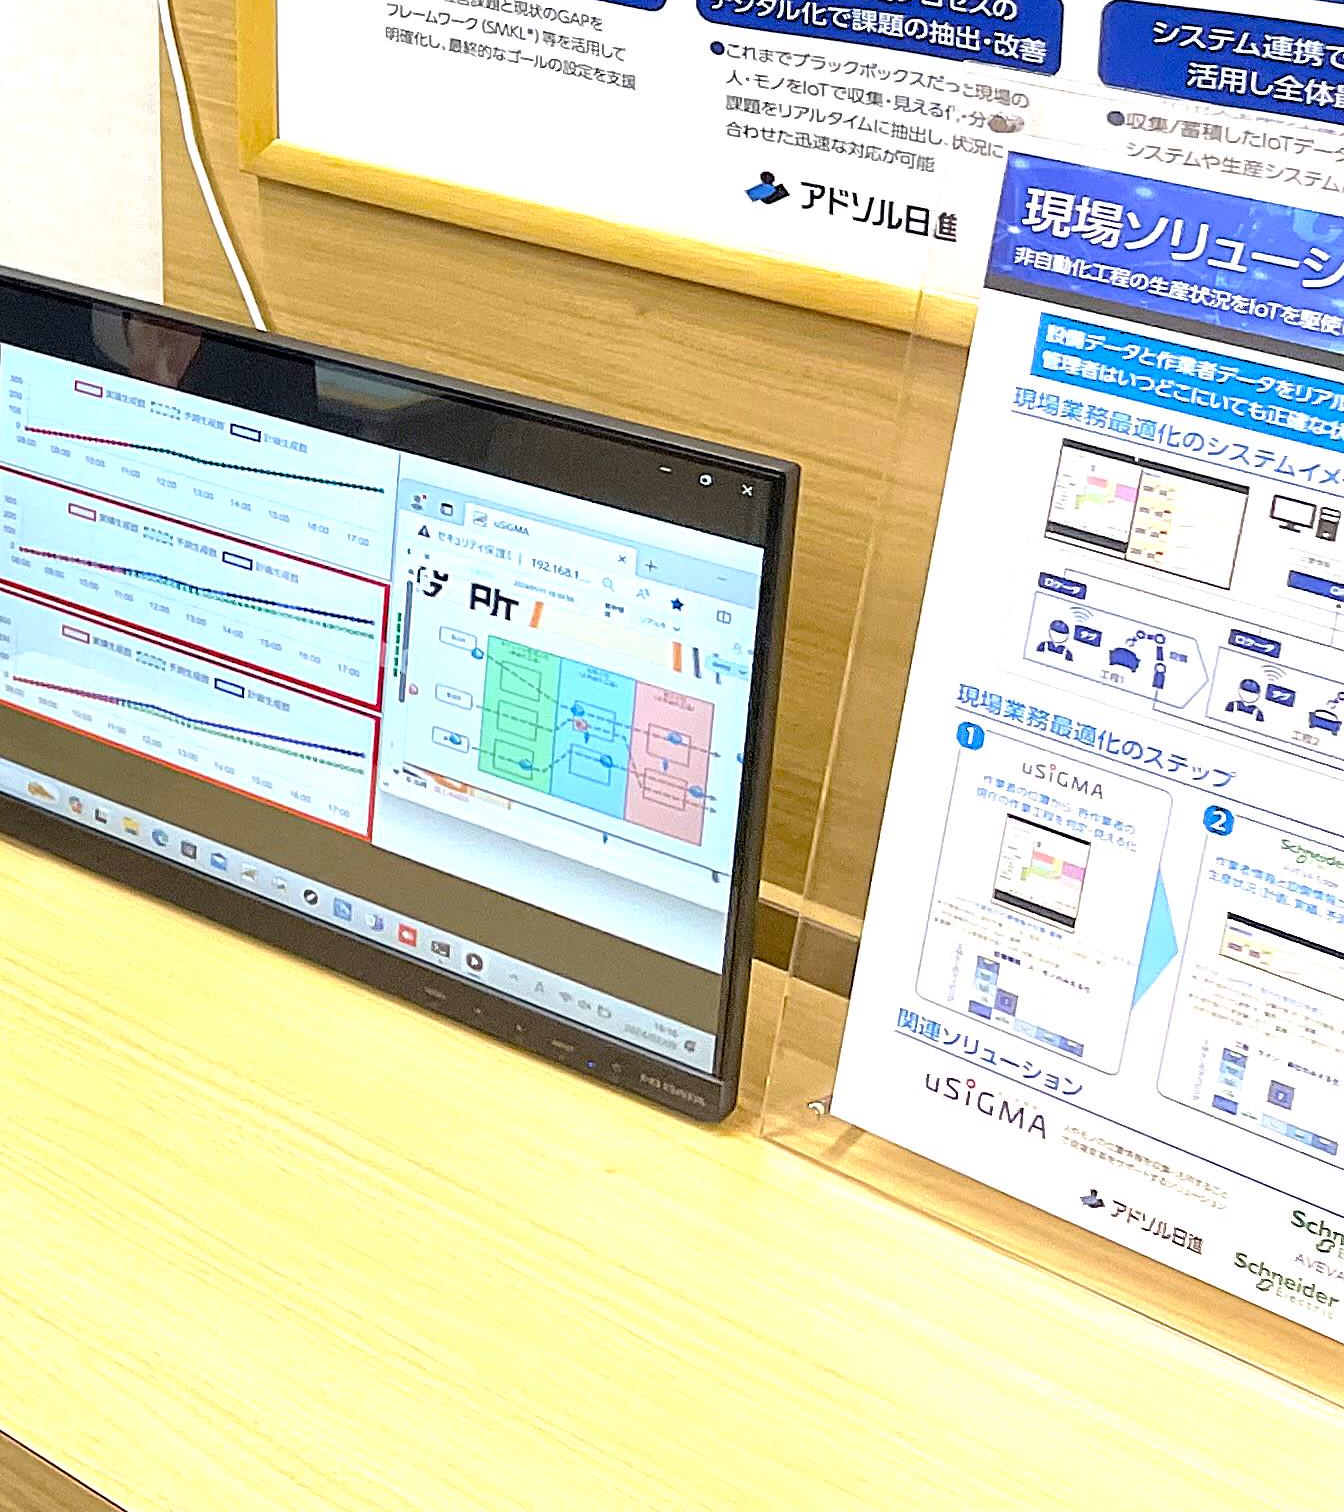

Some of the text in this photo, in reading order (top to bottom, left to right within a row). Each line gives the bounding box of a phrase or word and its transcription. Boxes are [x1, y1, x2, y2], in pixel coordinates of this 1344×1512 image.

[726, 122, 936, 173] 合わせた迅速な対応が可能
[1125, 142, 1344, 194] システムや生産システム
[799, 181, 959, 243] アドソル日進
[1021, 186, 1344, 289] 現場ソリューシ
[1012, 386, 1344, 486] 現場業務最適化のシステムイメ
[956, 683, 1239, 789] 現場業務最適化のステップ
[896, 1006, 1084, 1097] 関連ソリューション
[1110, 1199, 1205, 1256] アドソル日進
[1233, 1252, 1340, 1308] Schneider
